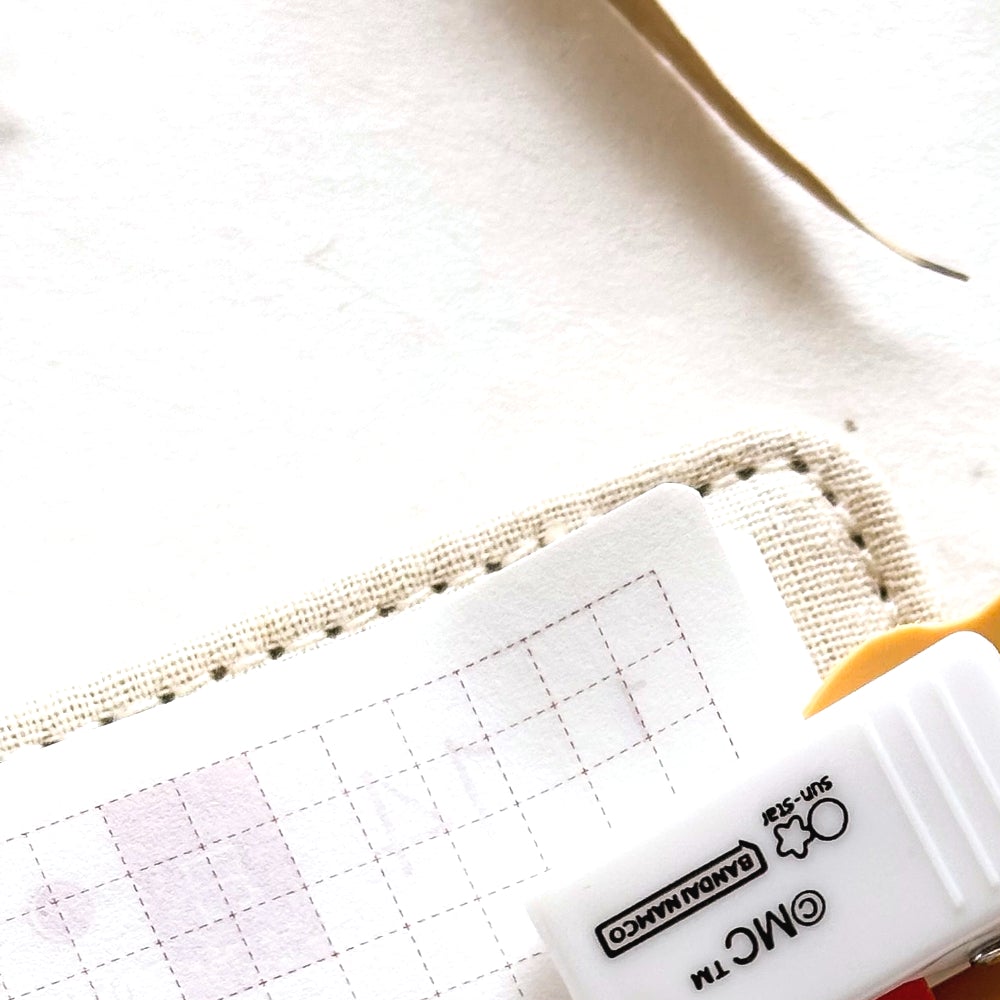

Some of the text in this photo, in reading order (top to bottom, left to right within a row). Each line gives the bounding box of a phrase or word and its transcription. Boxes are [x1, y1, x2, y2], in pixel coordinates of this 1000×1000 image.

[761, 775, 833, 827] sun-star
[608, 854, 755, 943] BANDAI NAMCO
